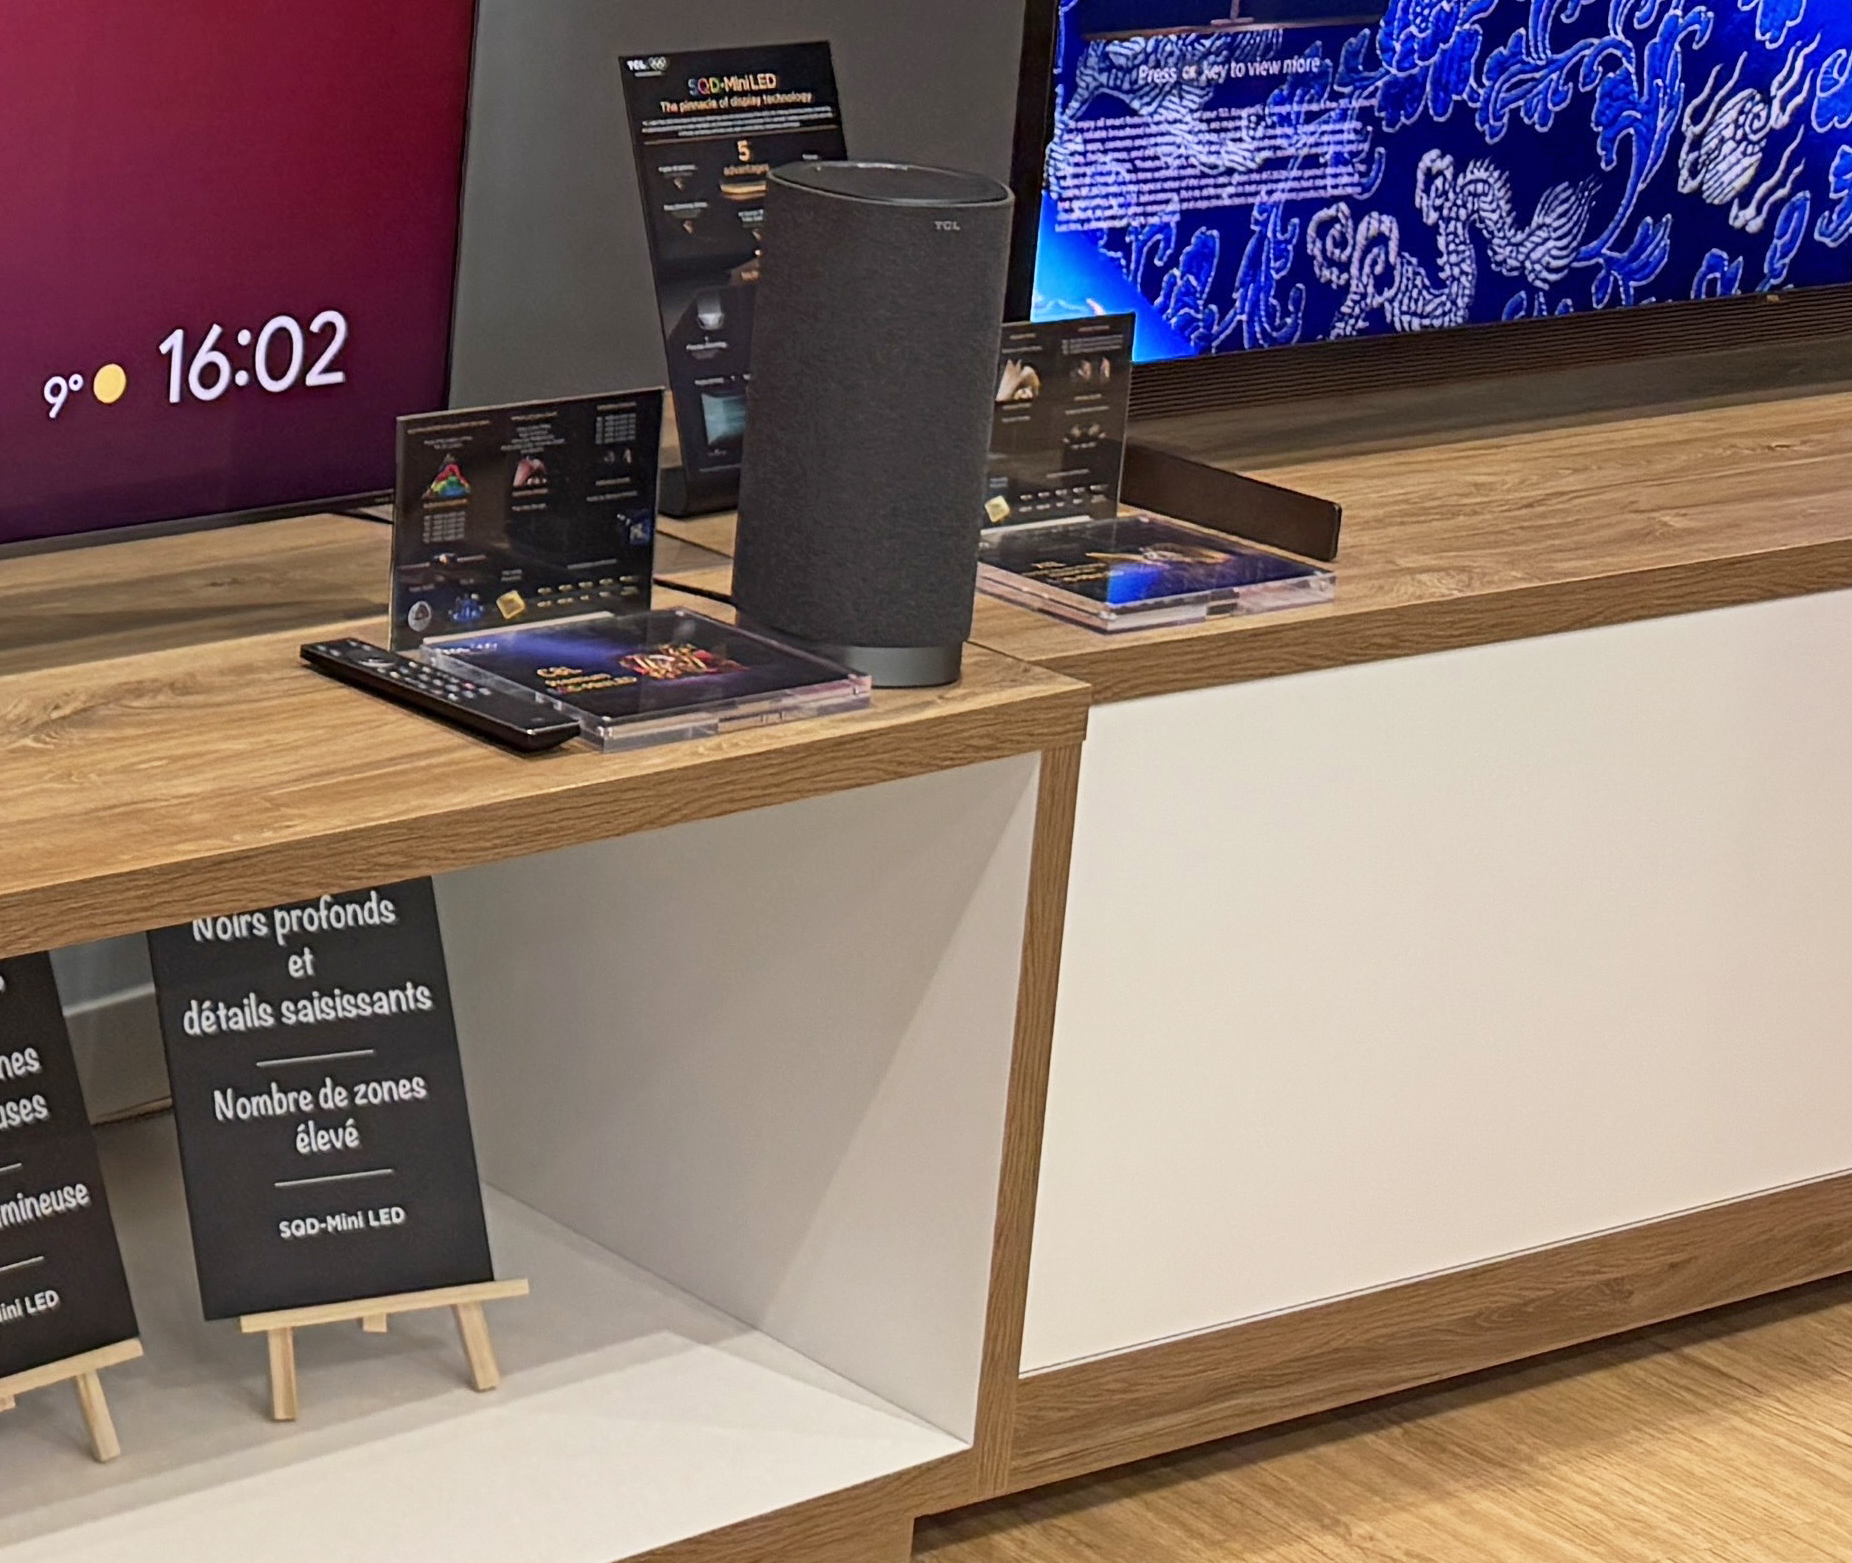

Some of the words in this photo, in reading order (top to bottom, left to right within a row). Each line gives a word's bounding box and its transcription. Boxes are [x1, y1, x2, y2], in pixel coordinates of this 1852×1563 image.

[1138, 64, 1177, 84] Press
[1230, 60, 1246, 78] to
[1247, 57, 1281, 76] view
[1283, 57, 1321, 74] more
[736, 140, 751, 161] 5
[935, 221, 961, 231] TCL
[158, 309, 347, 403] 16:02
[273, 890, 396, 945] profonds
[288, 947, 314, 978] et
[183, 992, 274, 1036] détails
[281, 981, 433, 1025] saisissants
[213, 1081, 313, 1122] Nombre
[319, 1077, 348, 1110] de
[353, 1076, 427, 1106] zones
[296, 1118, 360, 1154] élevé
[279, 1210, 365, 1239] SQD-Mini
[368, 1206, 406, 1227] LED
[25, 1289, 61, 1314] LED
